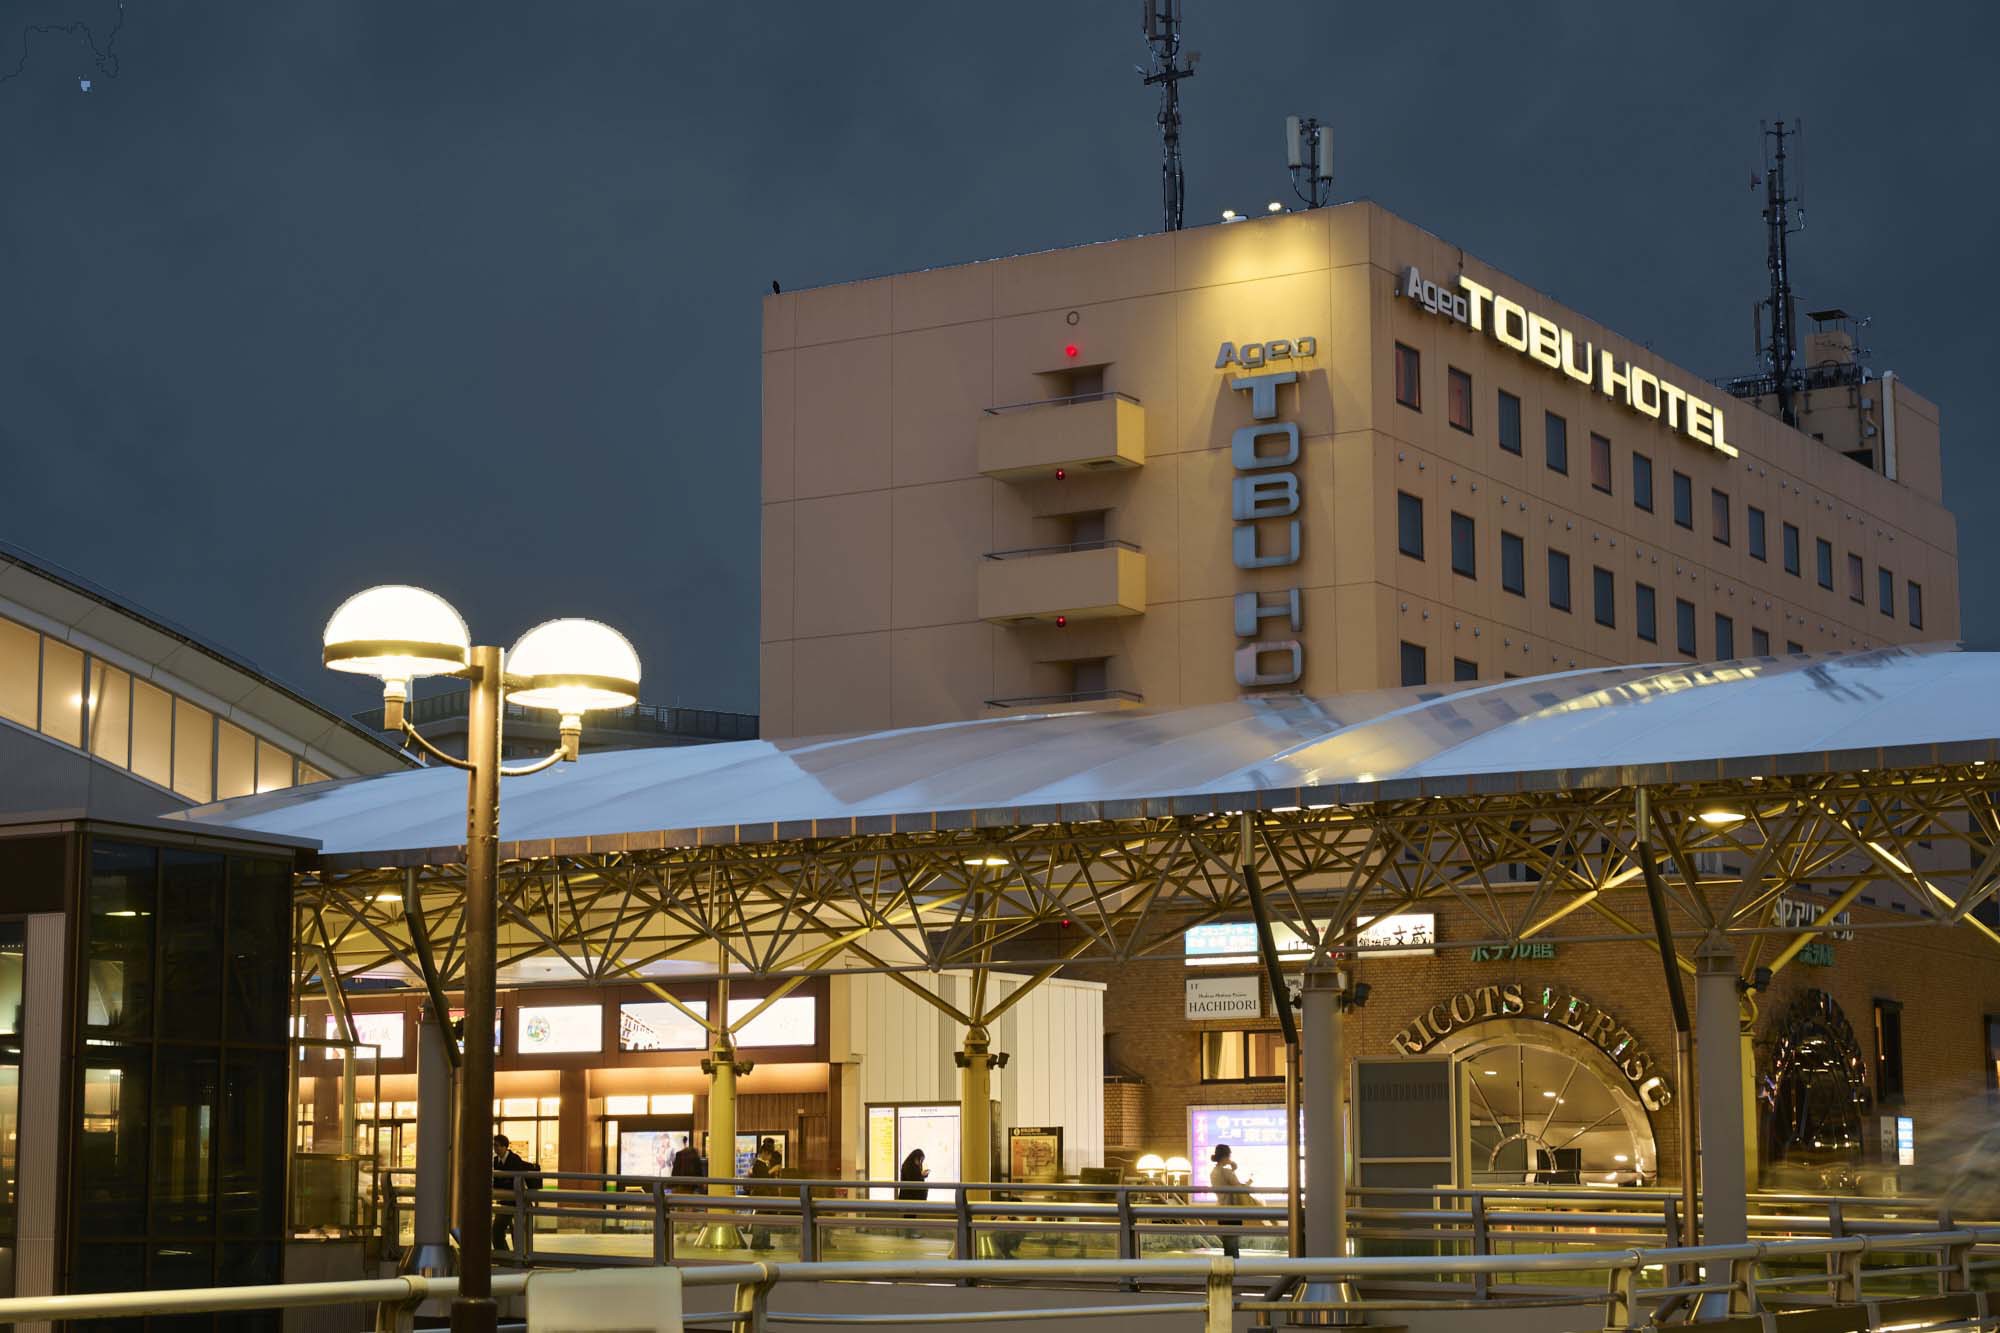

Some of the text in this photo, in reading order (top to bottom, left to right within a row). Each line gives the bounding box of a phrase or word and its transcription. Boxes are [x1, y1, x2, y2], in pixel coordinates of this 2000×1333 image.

[1215, 336, 1316, 369] Ageo
[1407, 266, 1739, 458] Ageo TOBU HOTEL
[1231, 371, 1302, 697] TOBU HO
[1189, 999, 1257, 1013] HACHIDORI
